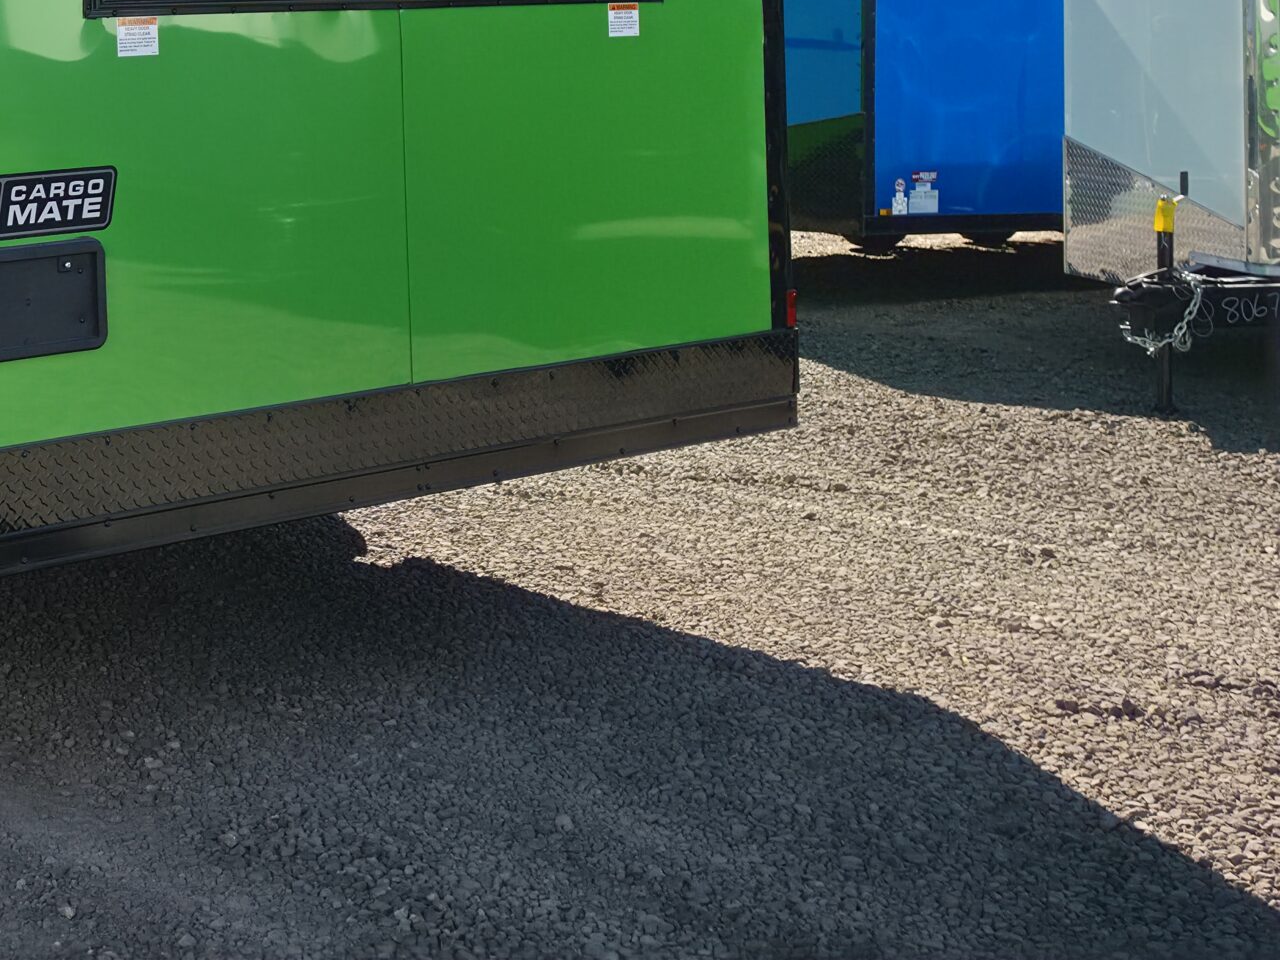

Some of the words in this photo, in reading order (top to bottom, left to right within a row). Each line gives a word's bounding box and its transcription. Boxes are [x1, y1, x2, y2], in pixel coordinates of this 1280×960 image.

[10, 178, 105, 202] CARGO
[6, 197, 103, 227] MATE
[1221, 292, 1280, 324] 8067
